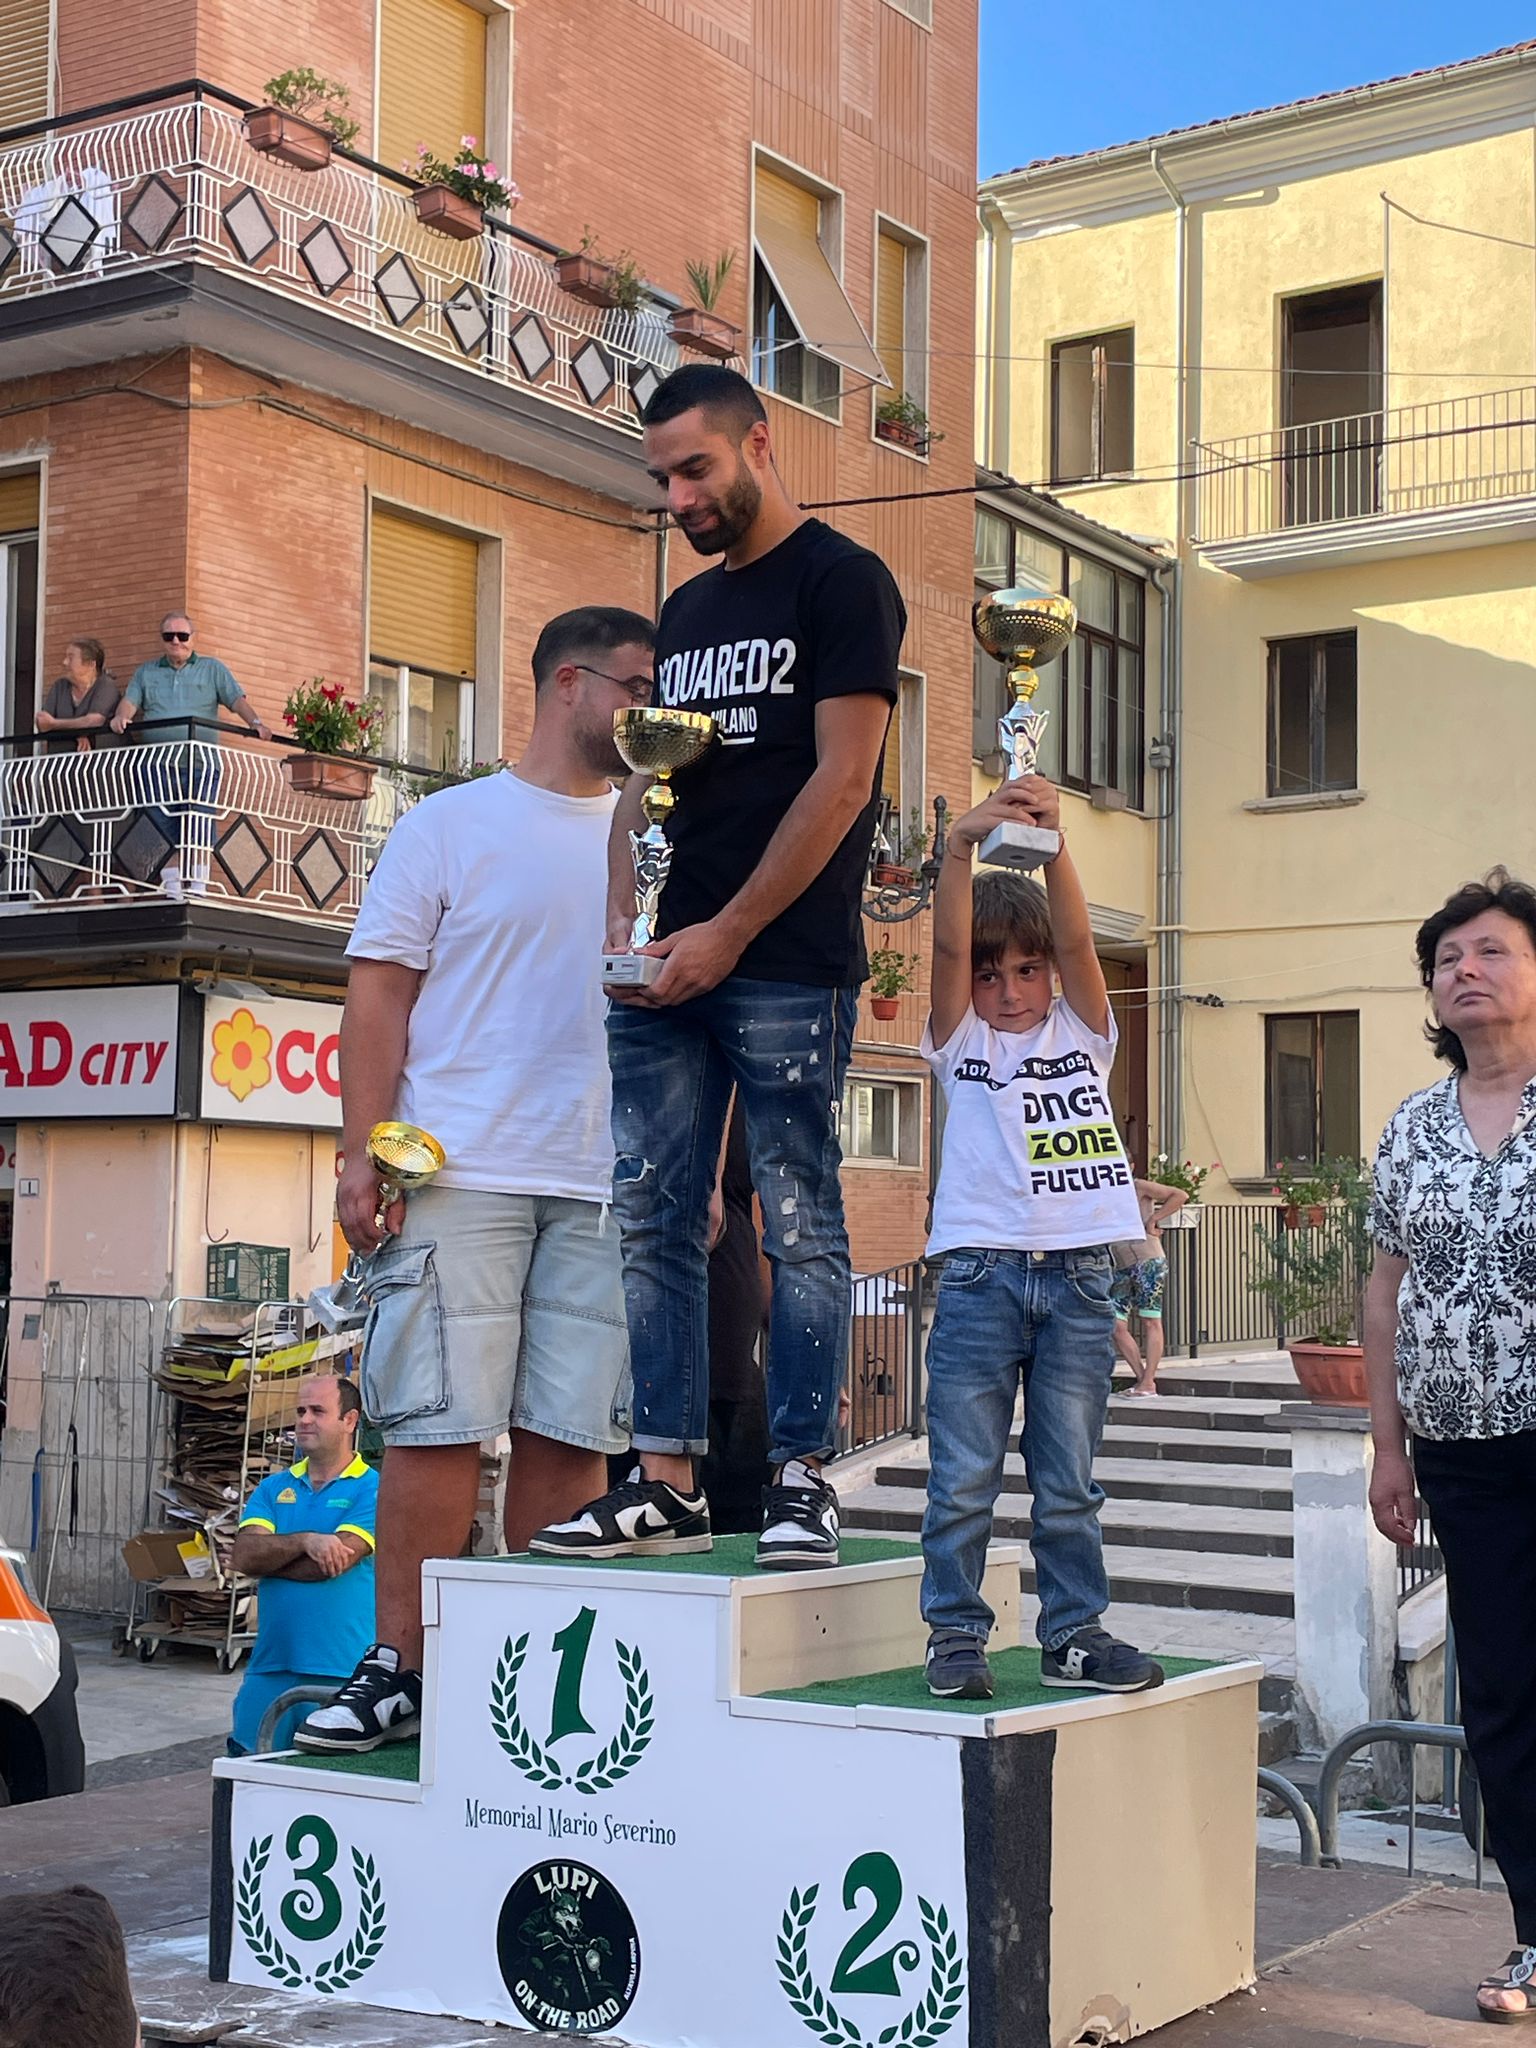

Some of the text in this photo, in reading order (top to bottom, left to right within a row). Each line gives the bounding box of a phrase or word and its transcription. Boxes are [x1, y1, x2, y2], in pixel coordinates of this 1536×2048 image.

[80, 1041, 169, 1086] CITY
[1030, 1128, 1118, 1160] ZONE
[1030, 1163, 1130, 1195] FUTURE
[545, 1605, 597, 1749] 1
[465, 1798, 677, 1846] Memorial Mario Severino
[280, 1814, 343, 1941] 3
[533, 1866, 599, 1900] LUPI
[829, 1851, 921, 1997] 2
[514, 1979, 621, 2030] ON THE ROAD
